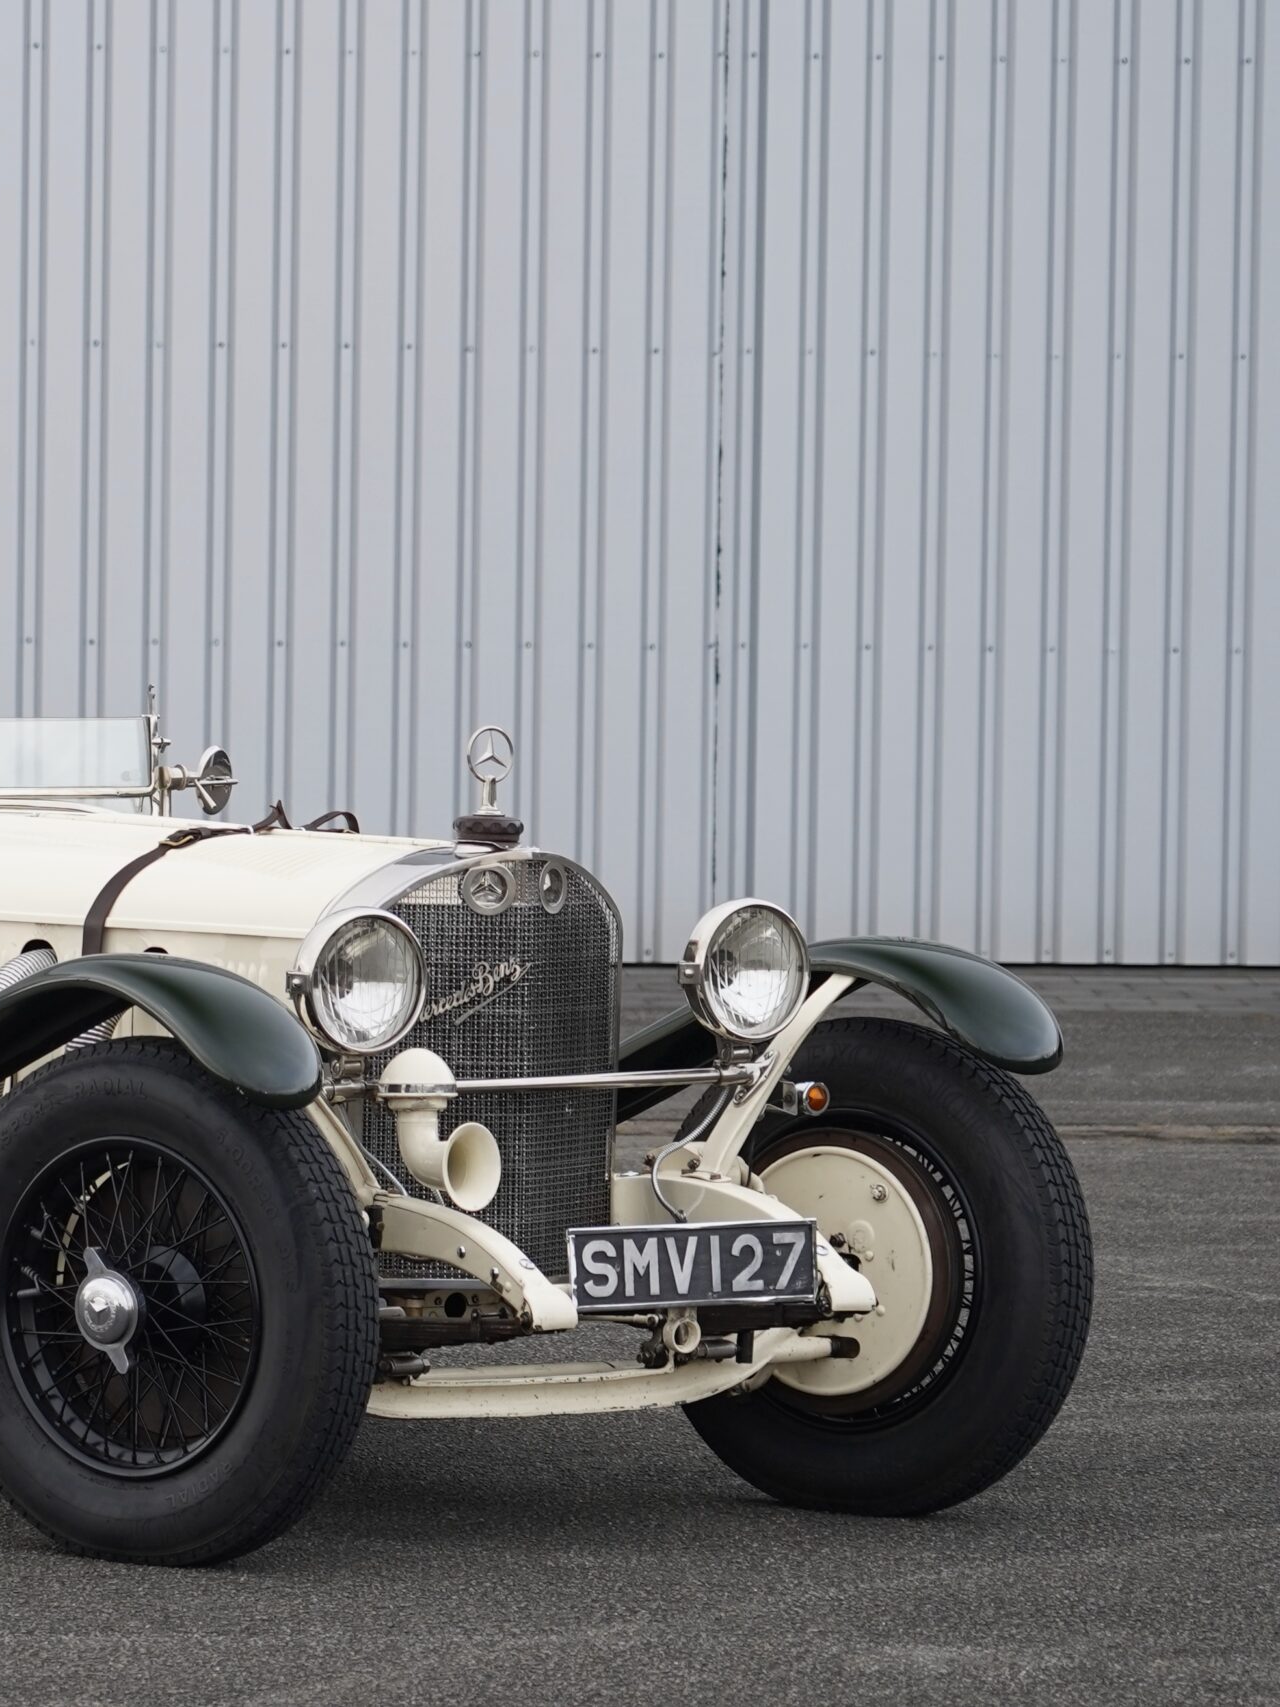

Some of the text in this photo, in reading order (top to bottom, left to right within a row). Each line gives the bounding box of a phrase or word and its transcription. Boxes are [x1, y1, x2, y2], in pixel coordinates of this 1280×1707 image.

[419, 980, 477, 1023] ercedes
[0, 1090, 56, 1147] SPORT
[72, 1078, 148, 1100] RADIAL
[164, 1460, 234, 1507] RADIAL
